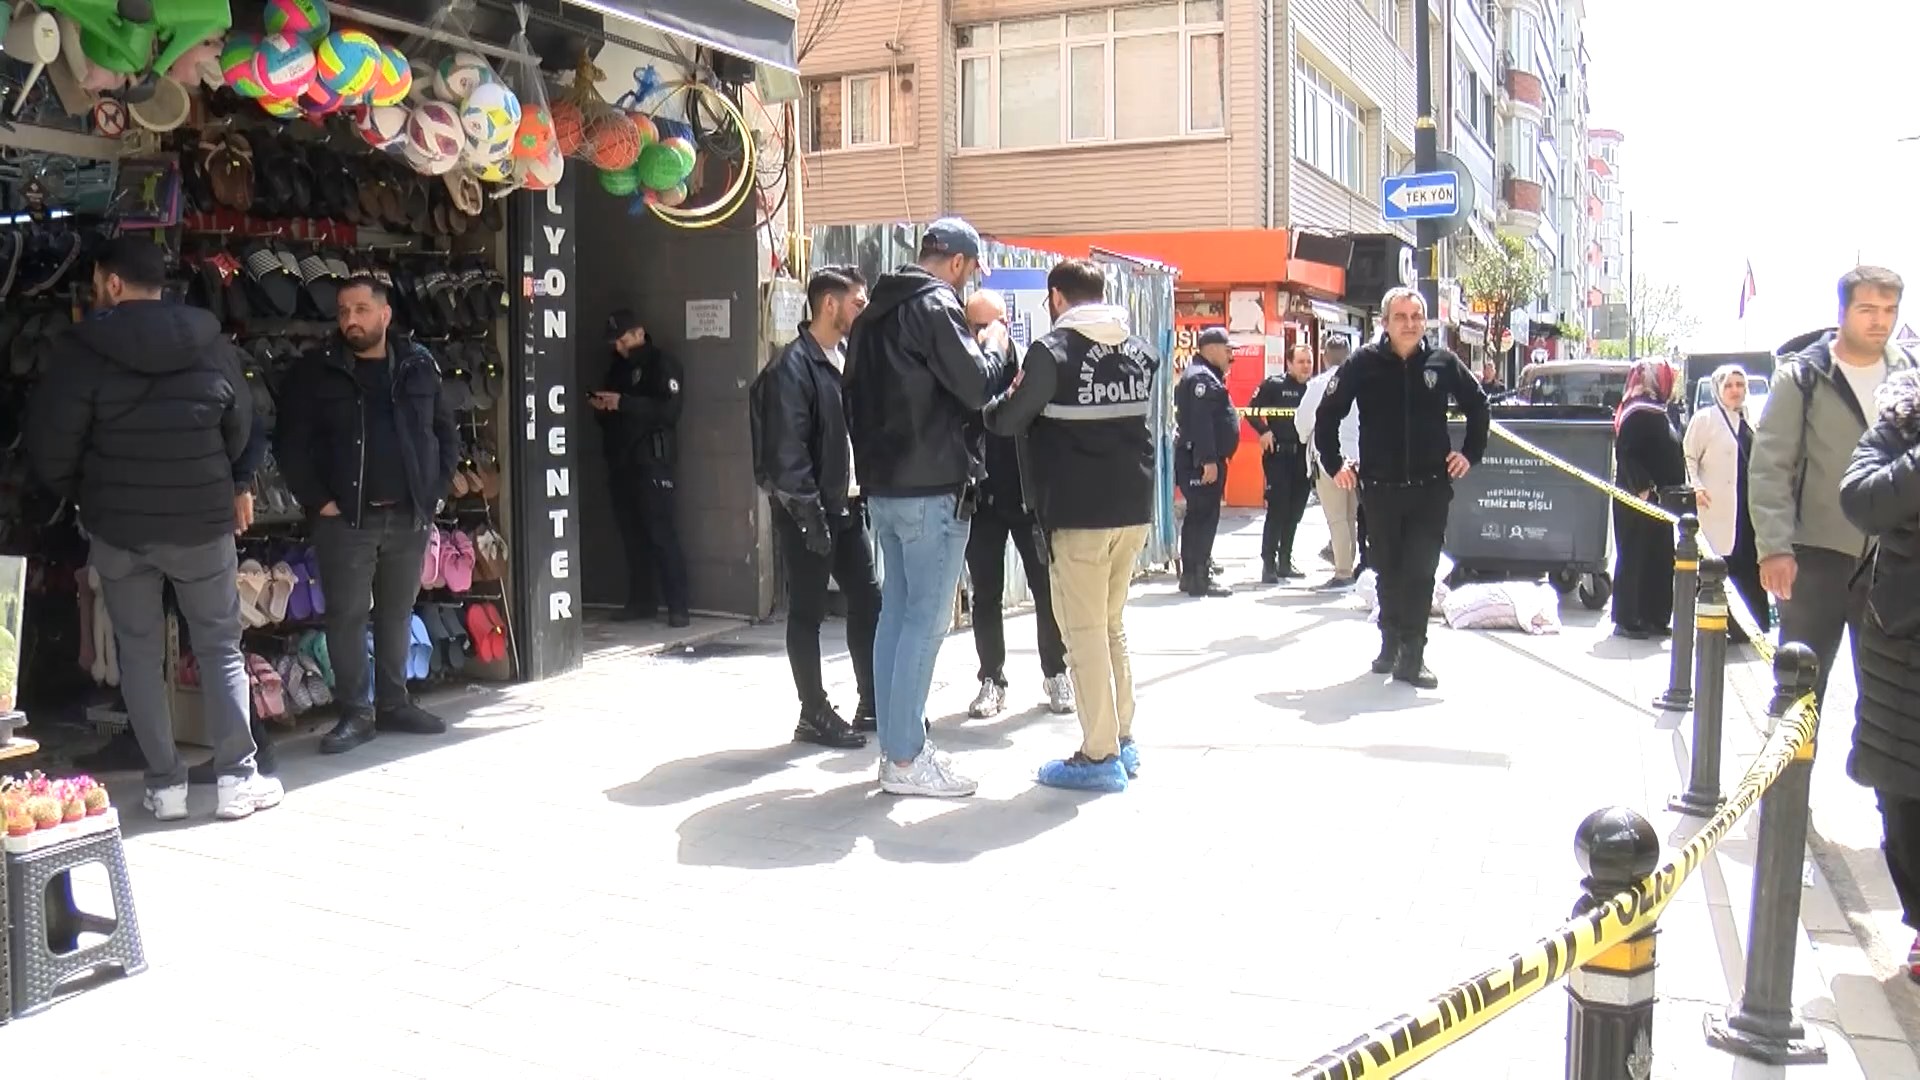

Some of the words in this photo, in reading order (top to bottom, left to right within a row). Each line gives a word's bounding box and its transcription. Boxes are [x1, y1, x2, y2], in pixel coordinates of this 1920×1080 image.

[1406, 192, 1427, 204] TEK
[1431, 187, 1453, 201] YÖN
[546, 384, 572, 621] CENTER
